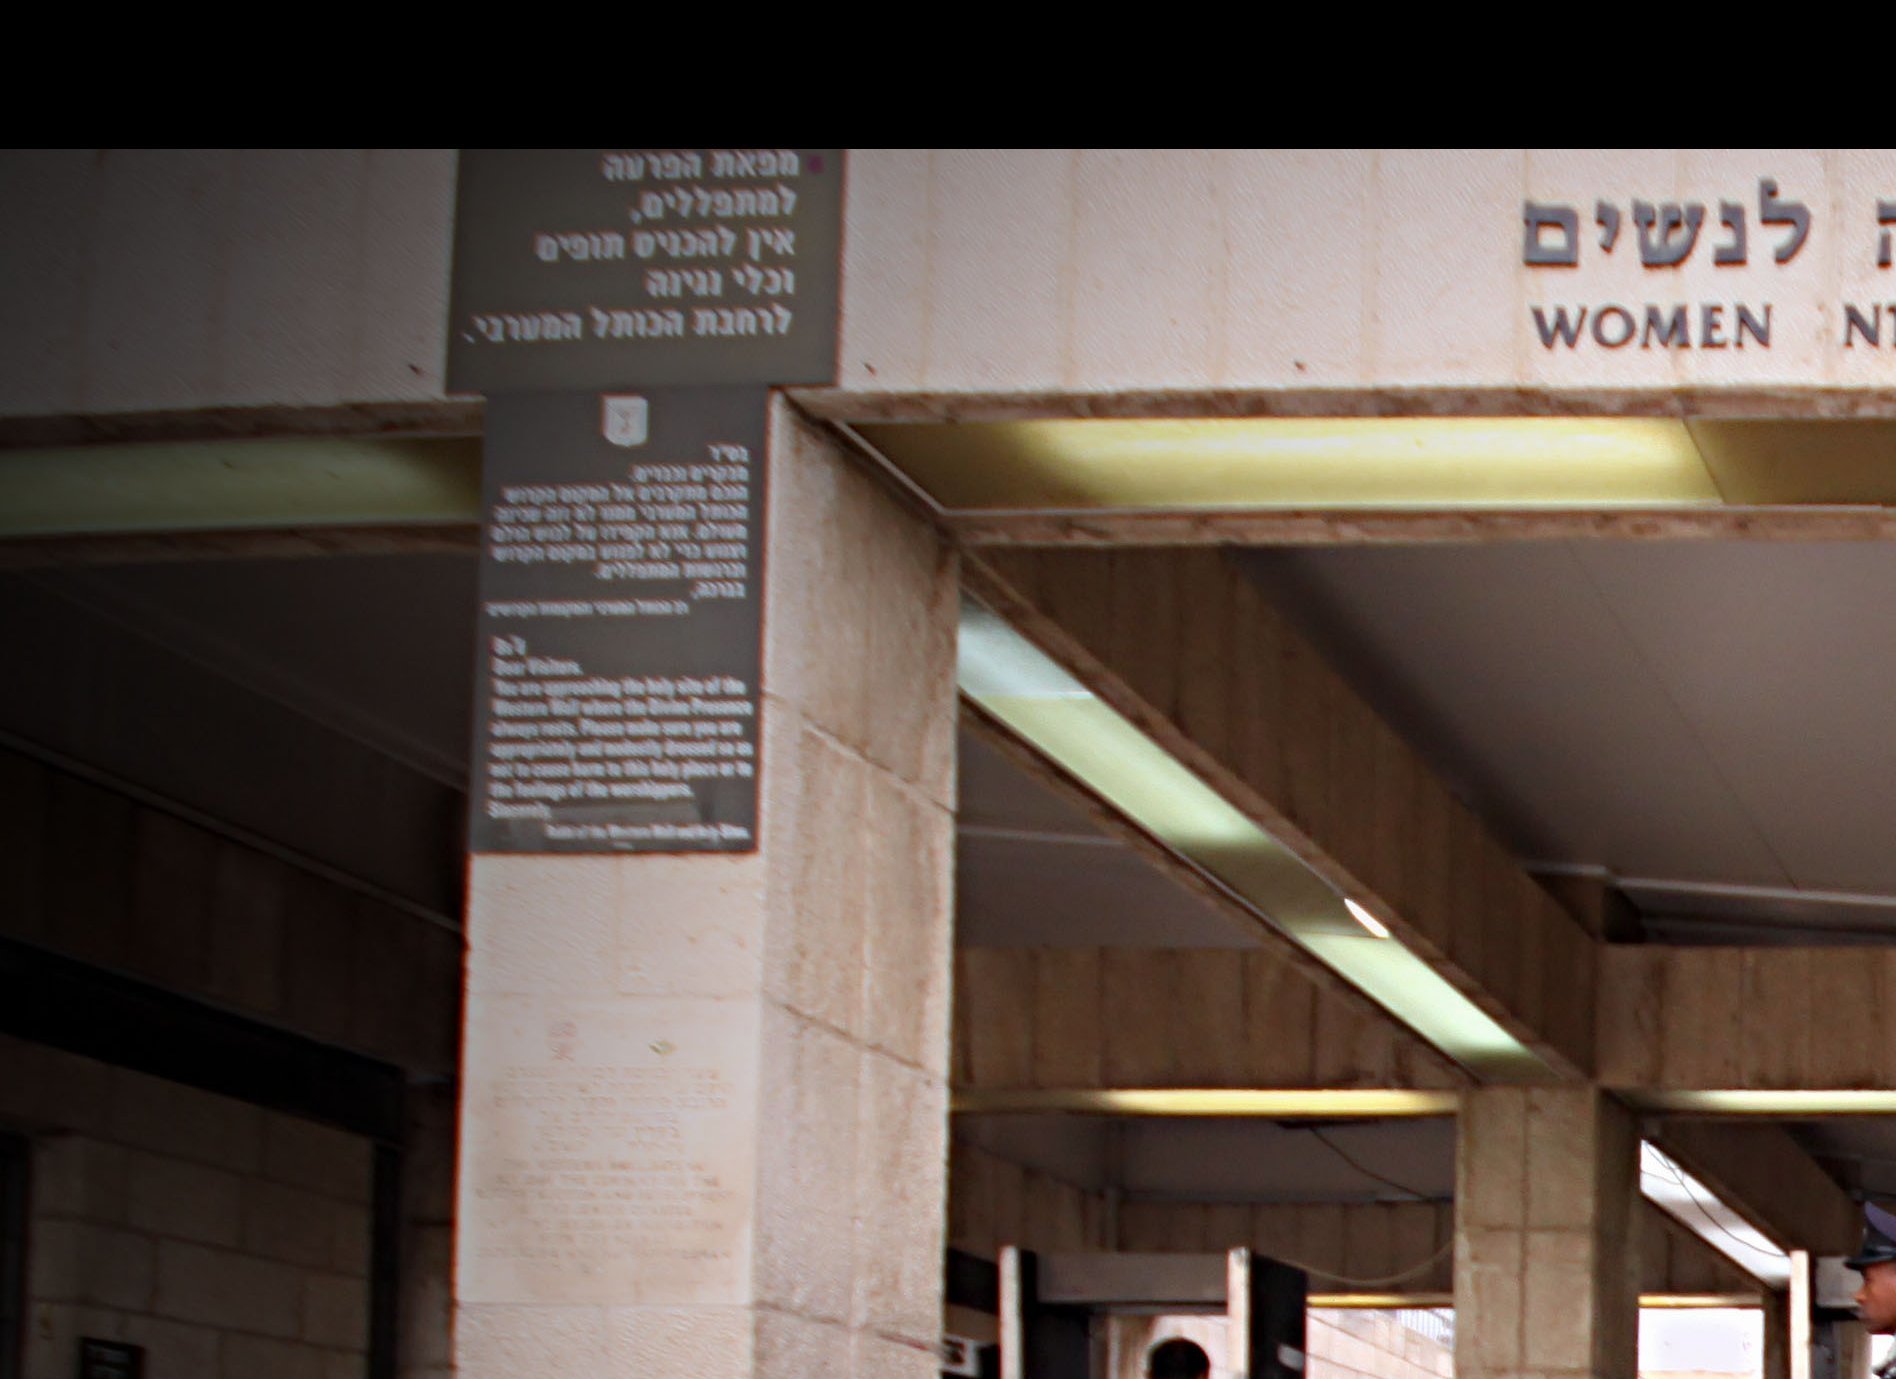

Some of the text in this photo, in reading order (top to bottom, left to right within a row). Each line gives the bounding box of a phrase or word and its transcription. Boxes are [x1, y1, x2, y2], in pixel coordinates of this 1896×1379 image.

[1524, 178, 1811, 268] לנשים
[534, 224, 796, 262] אין להכניס תופים
[590, 307, 685, 340] הכותל
[692, 302, 793, 337] לרחבת
[1532, 304, 1773, 350] WOMEN
